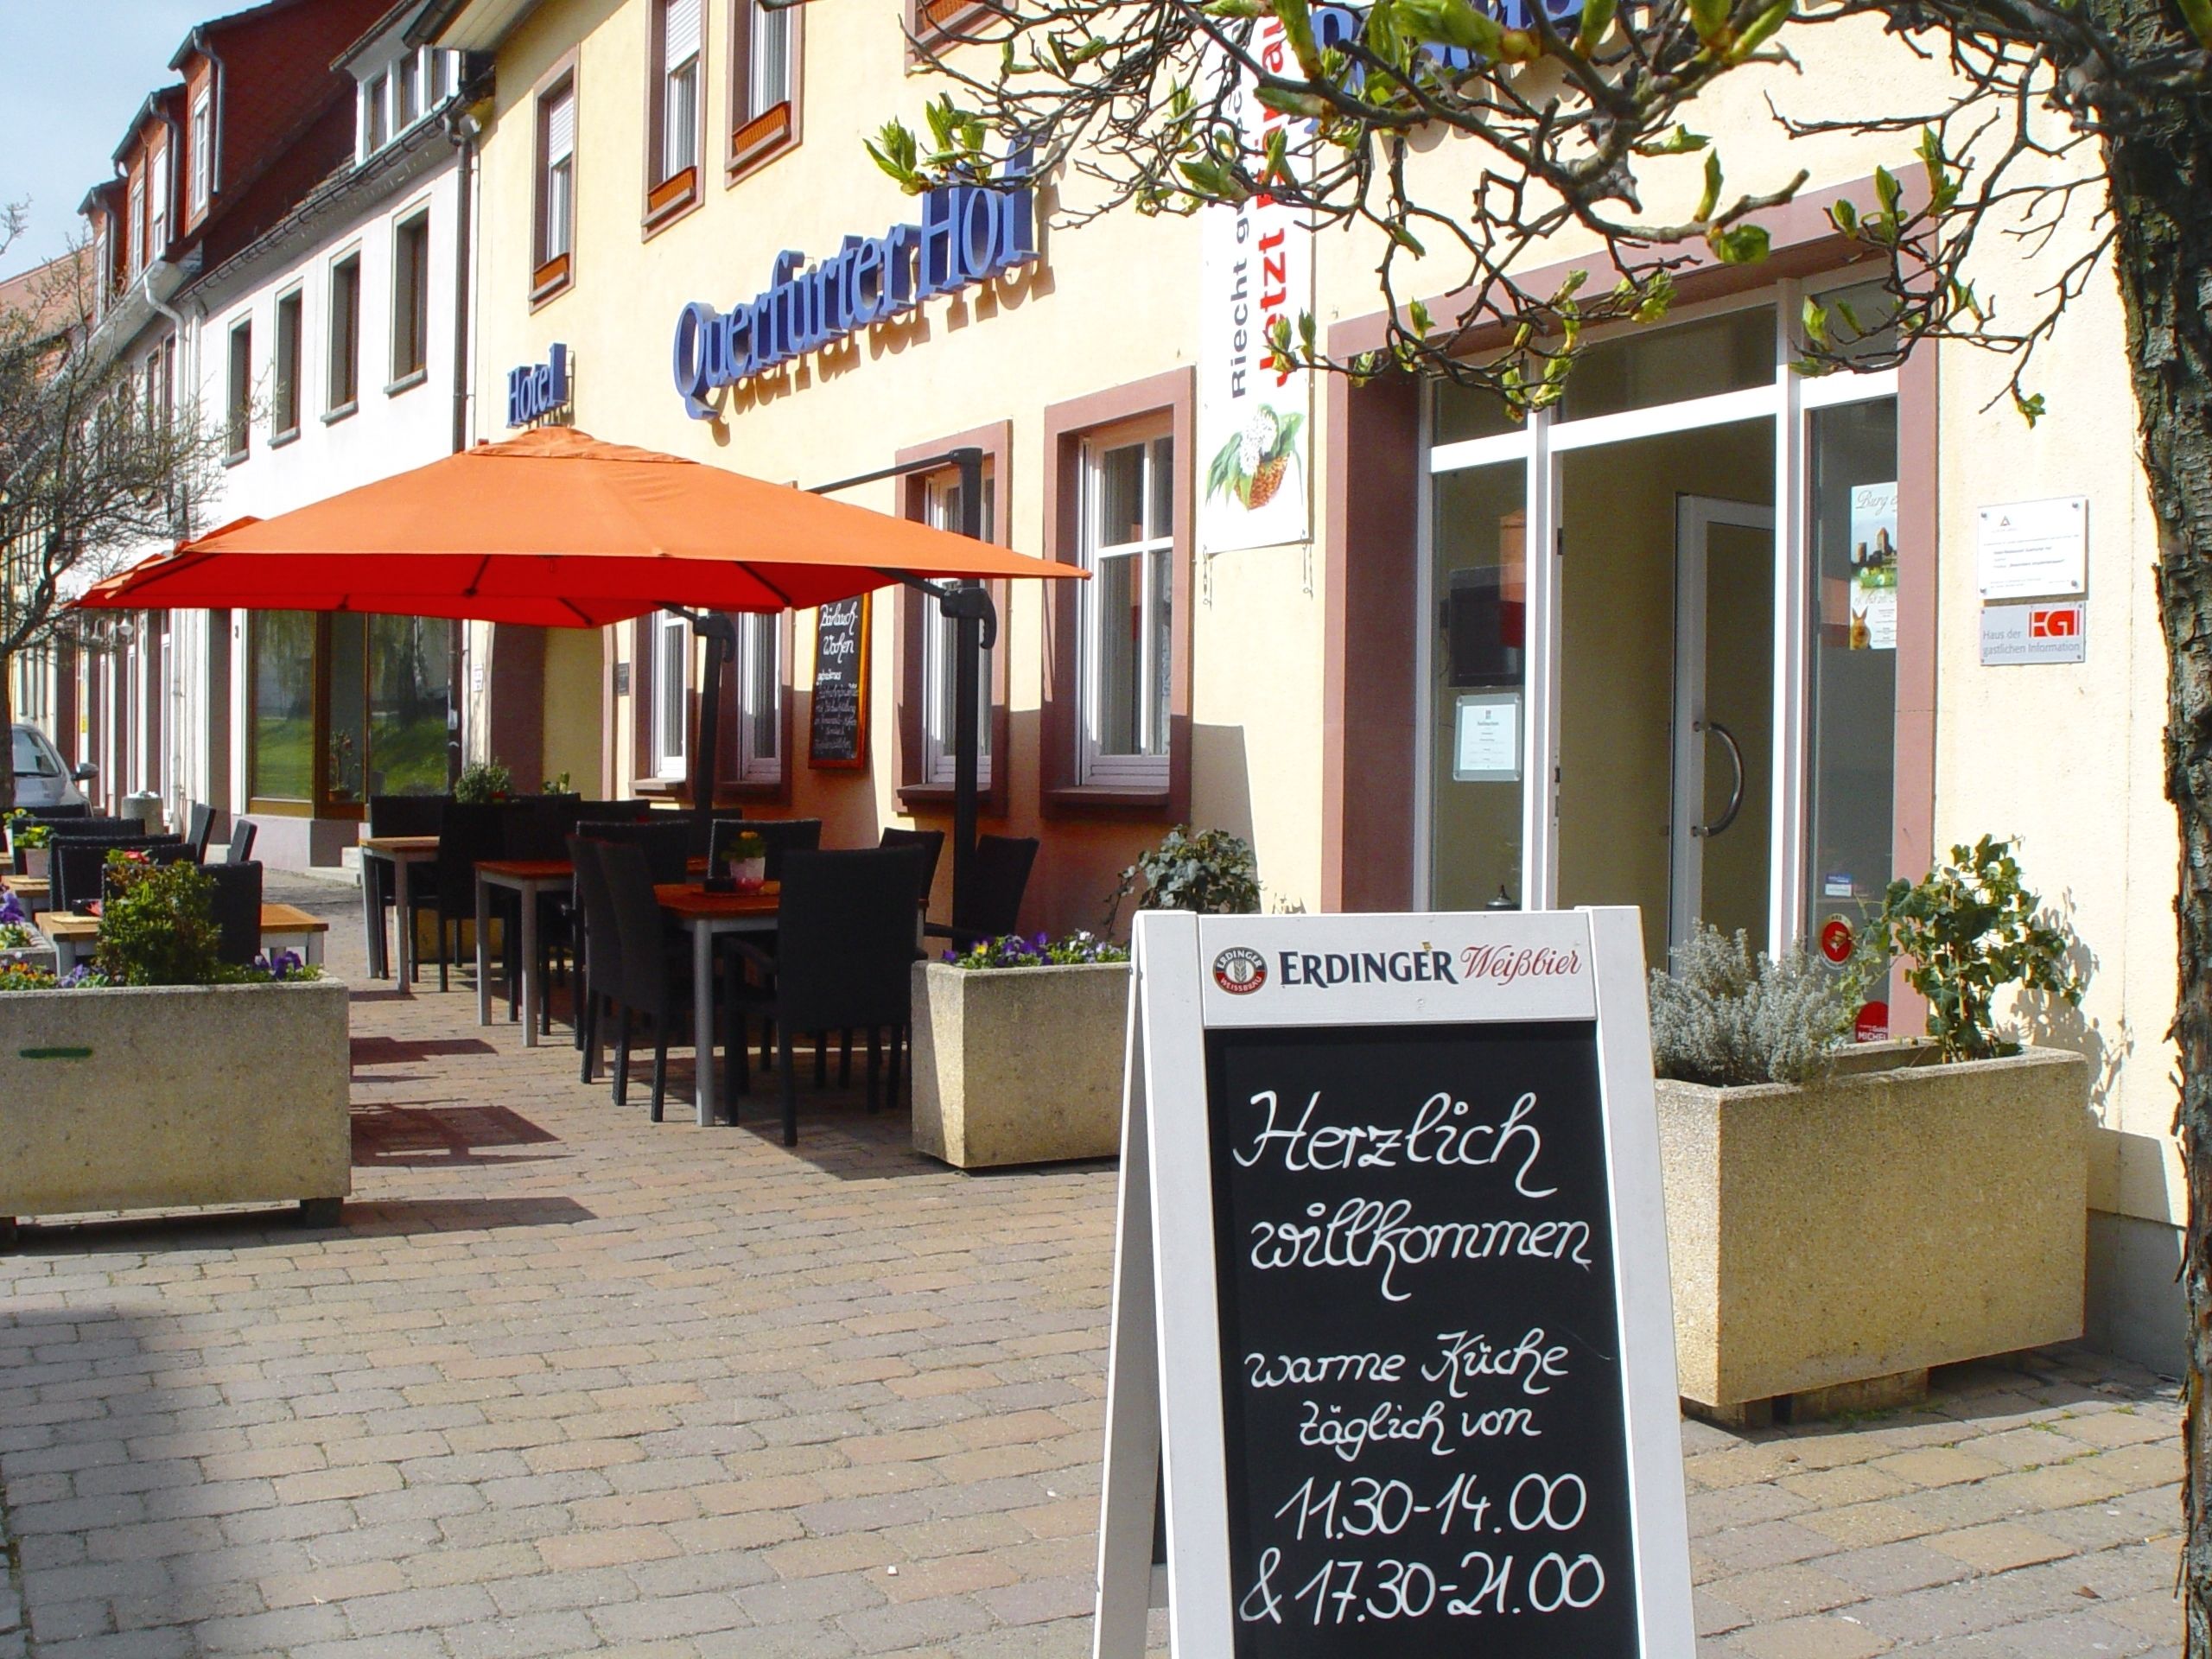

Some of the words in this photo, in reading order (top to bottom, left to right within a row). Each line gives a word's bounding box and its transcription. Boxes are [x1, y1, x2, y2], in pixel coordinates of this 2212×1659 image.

[673, 223, 921, 420] Querfurter
[916, 127, 1040, 301] Hof
[1230, 257, 1249, 399] Riecht
[505, 342, 567, 429] Hotel
[1982, 630, 2005, 641] Haus
[2008, 629, 2022, 640] der
[1982, 645, 2026, 658] gastlichen
[2028, 642, 2081, 655] Information
[1278, 950, 1459, 989] ERDINGER
[1460, 944, 1582, 986] Weißbier
[1233, 1090, 1557, 1198] Herzlich
[1250, 1198, 1592, 1301] willkommen
[1244, 1352, 1406, 1388] warme
[1421, 1327, 1569, 1399] Küche
[1300, 1401, 1456, 1462] täglich
[1462, 1408, 1542, 1438] von
[1240, 1548, 1282, 1624] &
